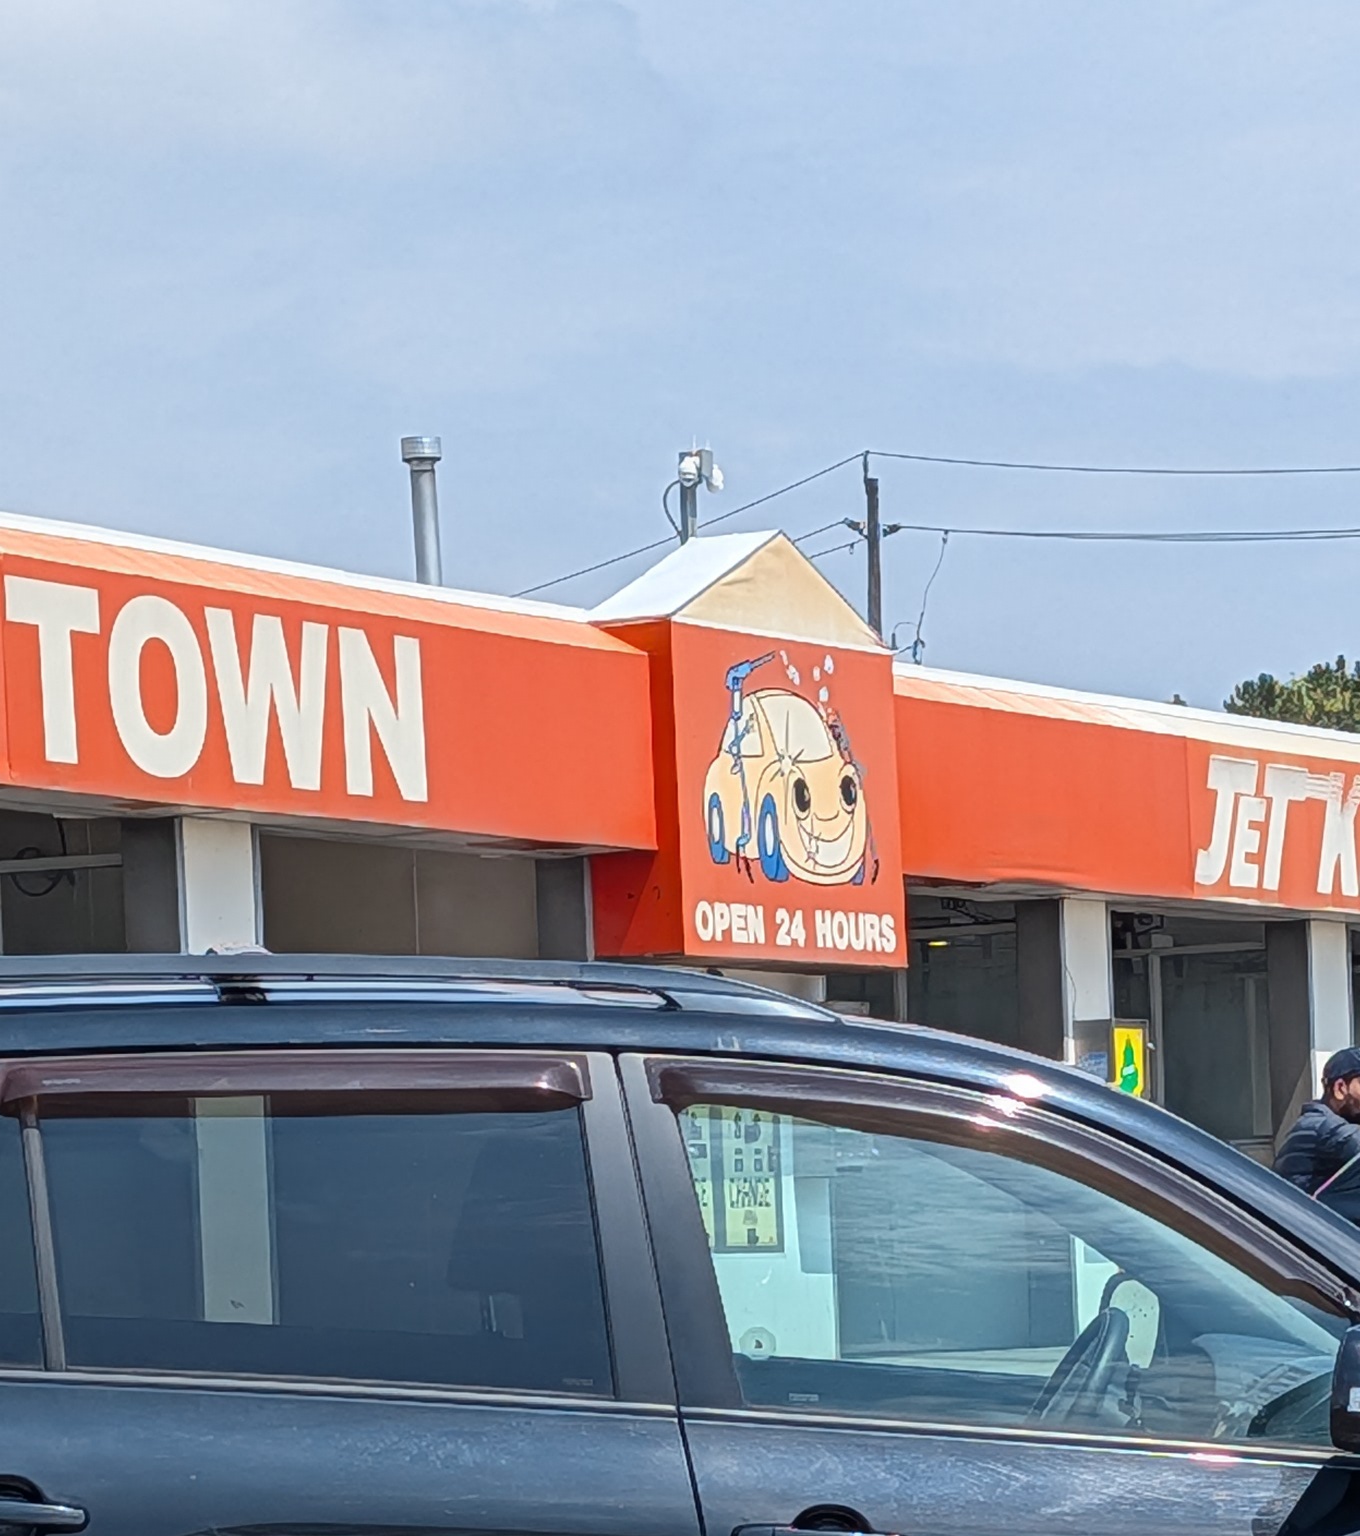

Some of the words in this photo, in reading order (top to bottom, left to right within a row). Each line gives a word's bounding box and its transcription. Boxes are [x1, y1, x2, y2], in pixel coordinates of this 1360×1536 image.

[3, 573, 428, 802] TOWN
[1194, 754, 1308, 891] JET
[695, 900, 766, 945] OPEN
[775, 907, 806, 948] 24
[814, 909, 897, 954] HOURS
